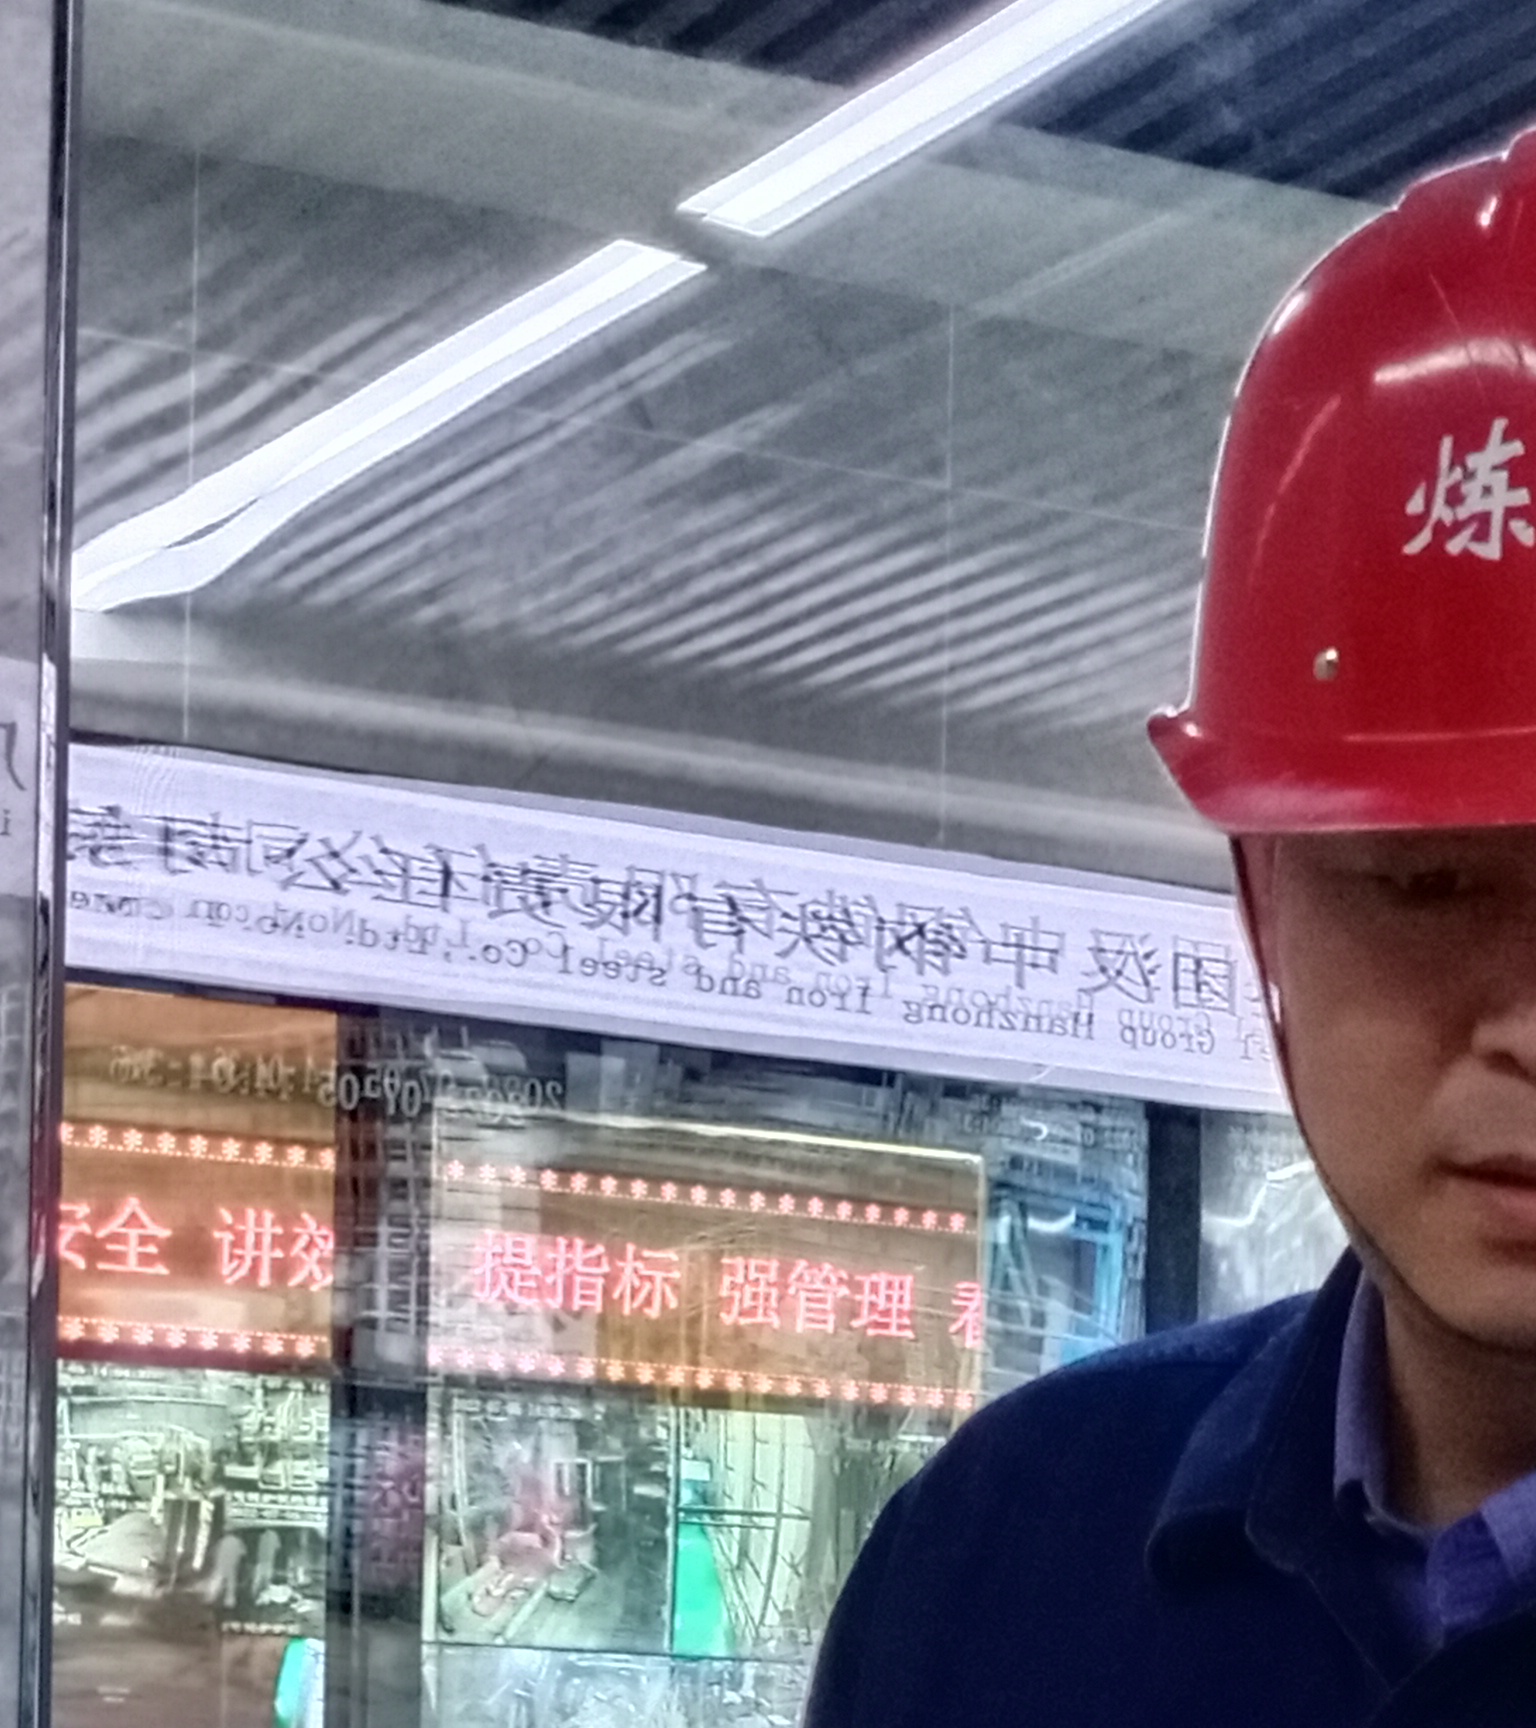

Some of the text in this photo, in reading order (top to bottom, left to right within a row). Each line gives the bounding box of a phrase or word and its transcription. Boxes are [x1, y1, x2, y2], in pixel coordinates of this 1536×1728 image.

[475, 1229, 681, 1319] 提指标
[718, 1257, 914, 1340] 强管理
